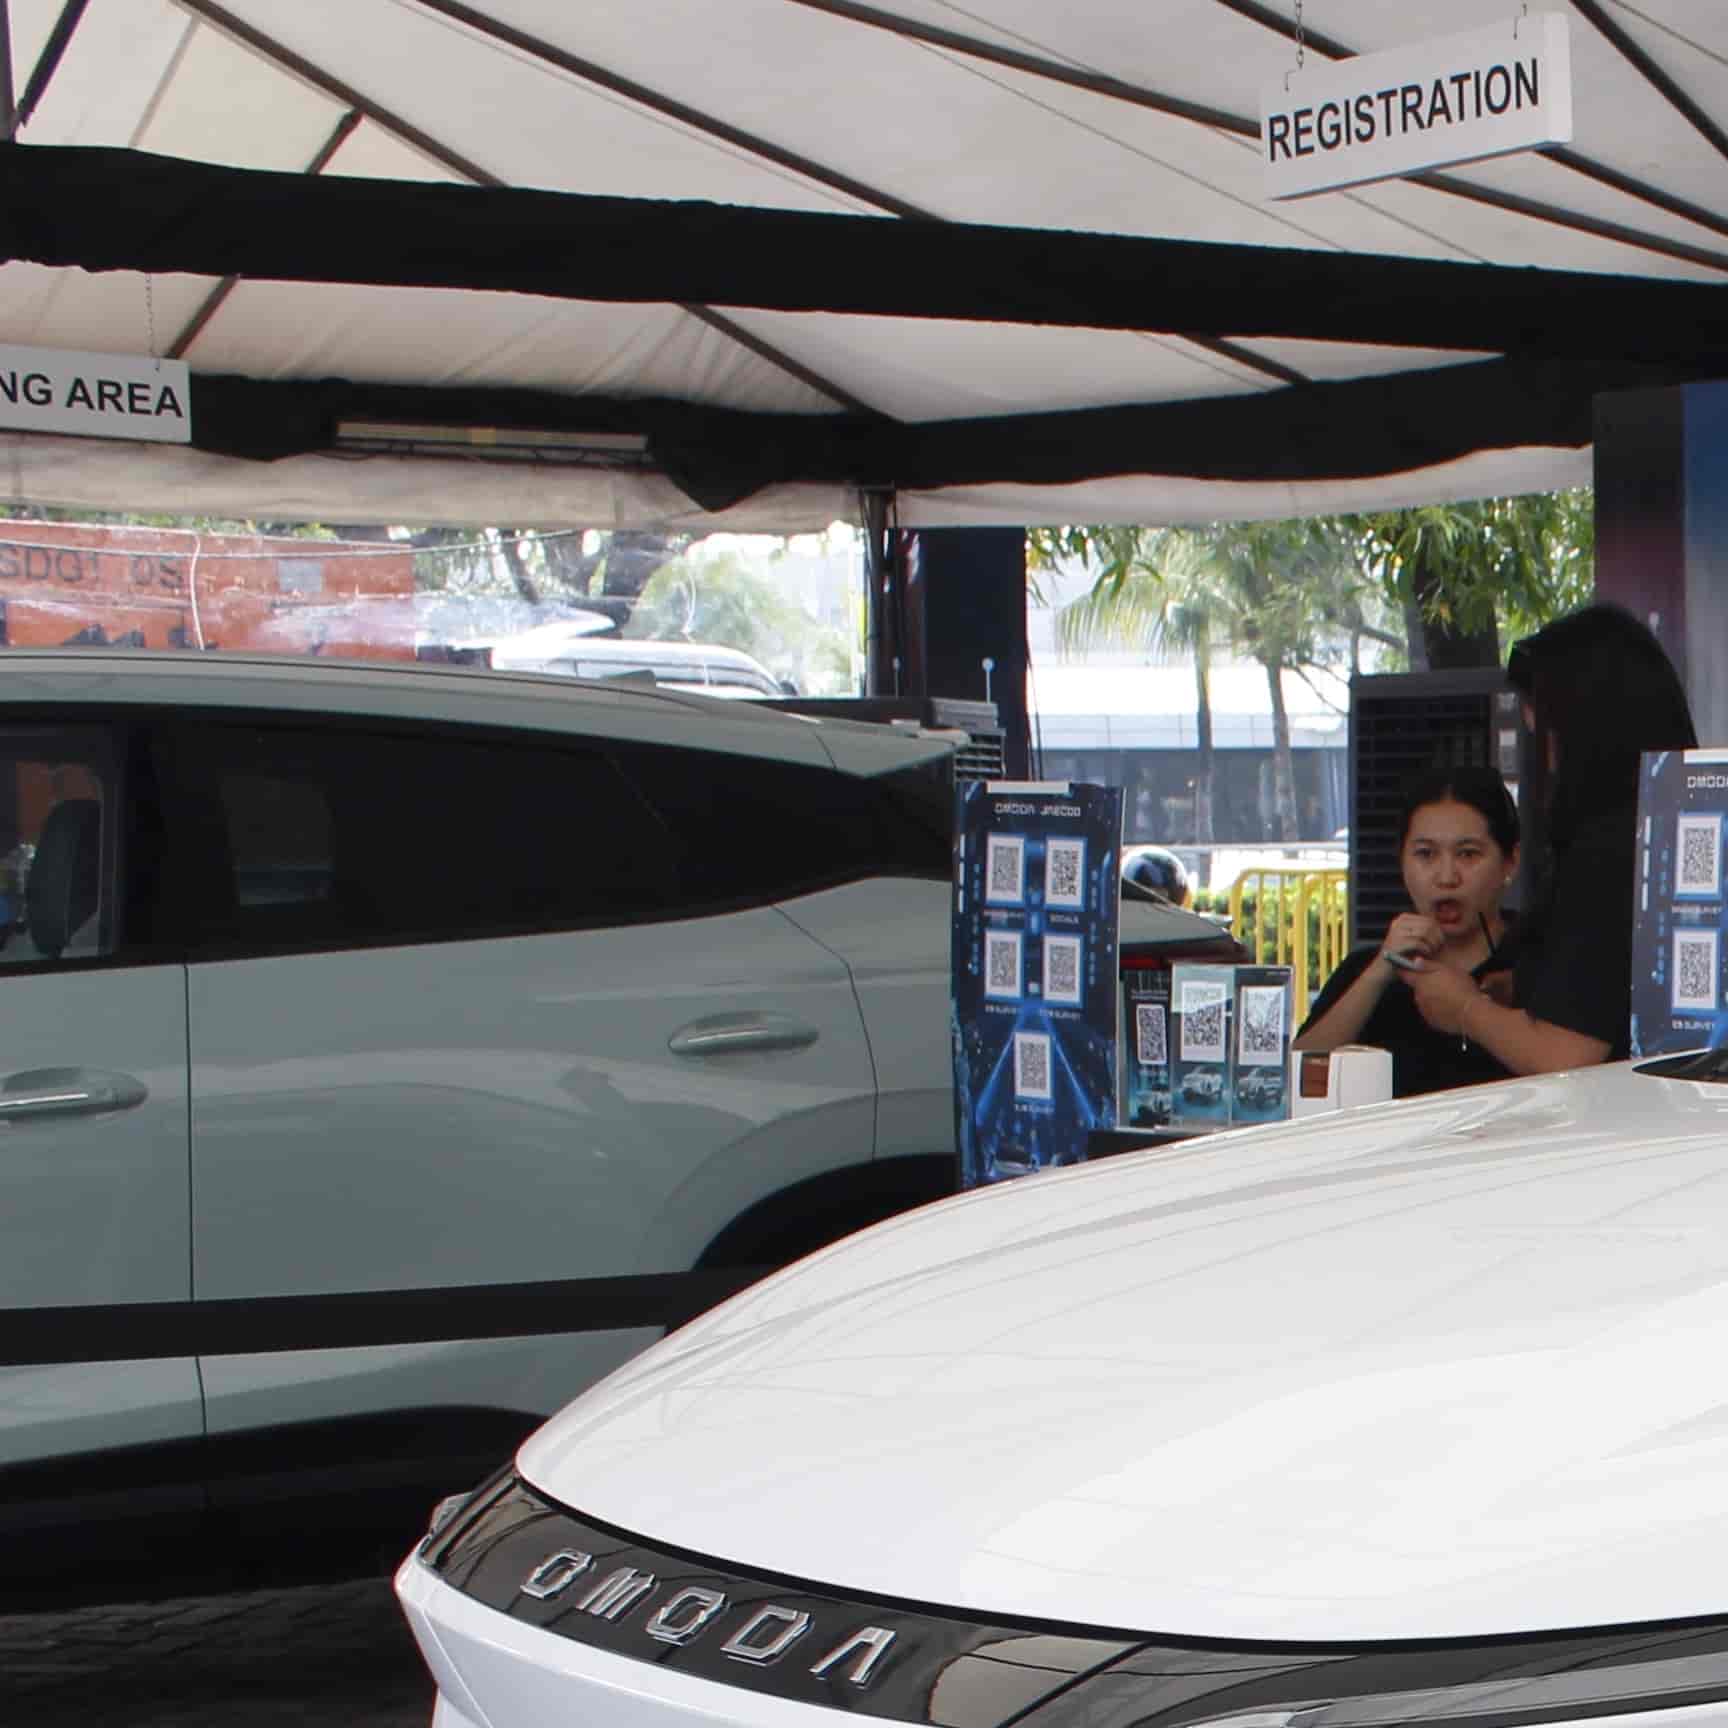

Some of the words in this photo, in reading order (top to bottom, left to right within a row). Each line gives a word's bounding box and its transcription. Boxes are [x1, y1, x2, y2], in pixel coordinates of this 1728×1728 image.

[1269, 58, 1539, 163] REGISTRATION
[66, 377, 183, 418] AREA
[520, 1547, 896, 1690] OMODA
